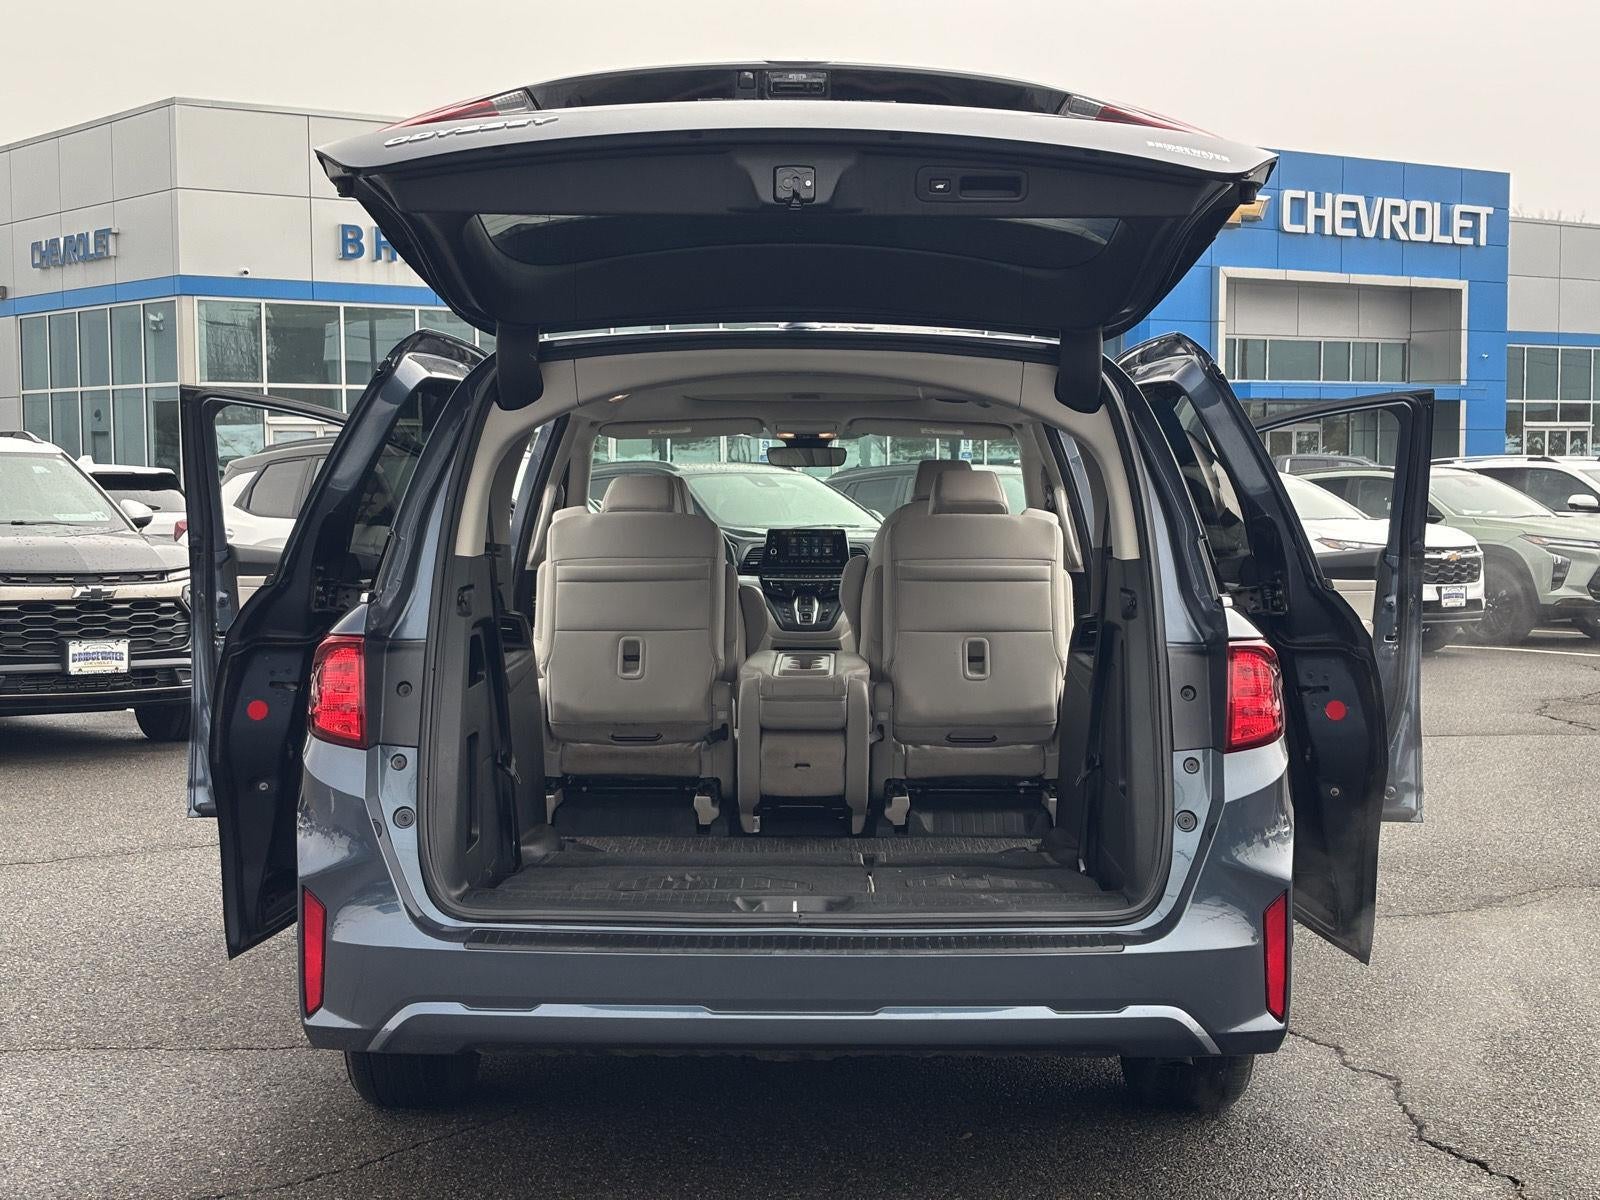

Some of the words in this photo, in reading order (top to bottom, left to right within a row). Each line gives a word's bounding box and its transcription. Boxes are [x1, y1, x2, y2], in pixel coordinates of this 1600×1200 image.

[384, 116, 559, 147] ODYSSEY
[1282, 189, 1495, 247] CHEVROLET
[31, 227, 119, 269] CHEVROLET
[71, 651, 124, 663] BRIDGEWATER
